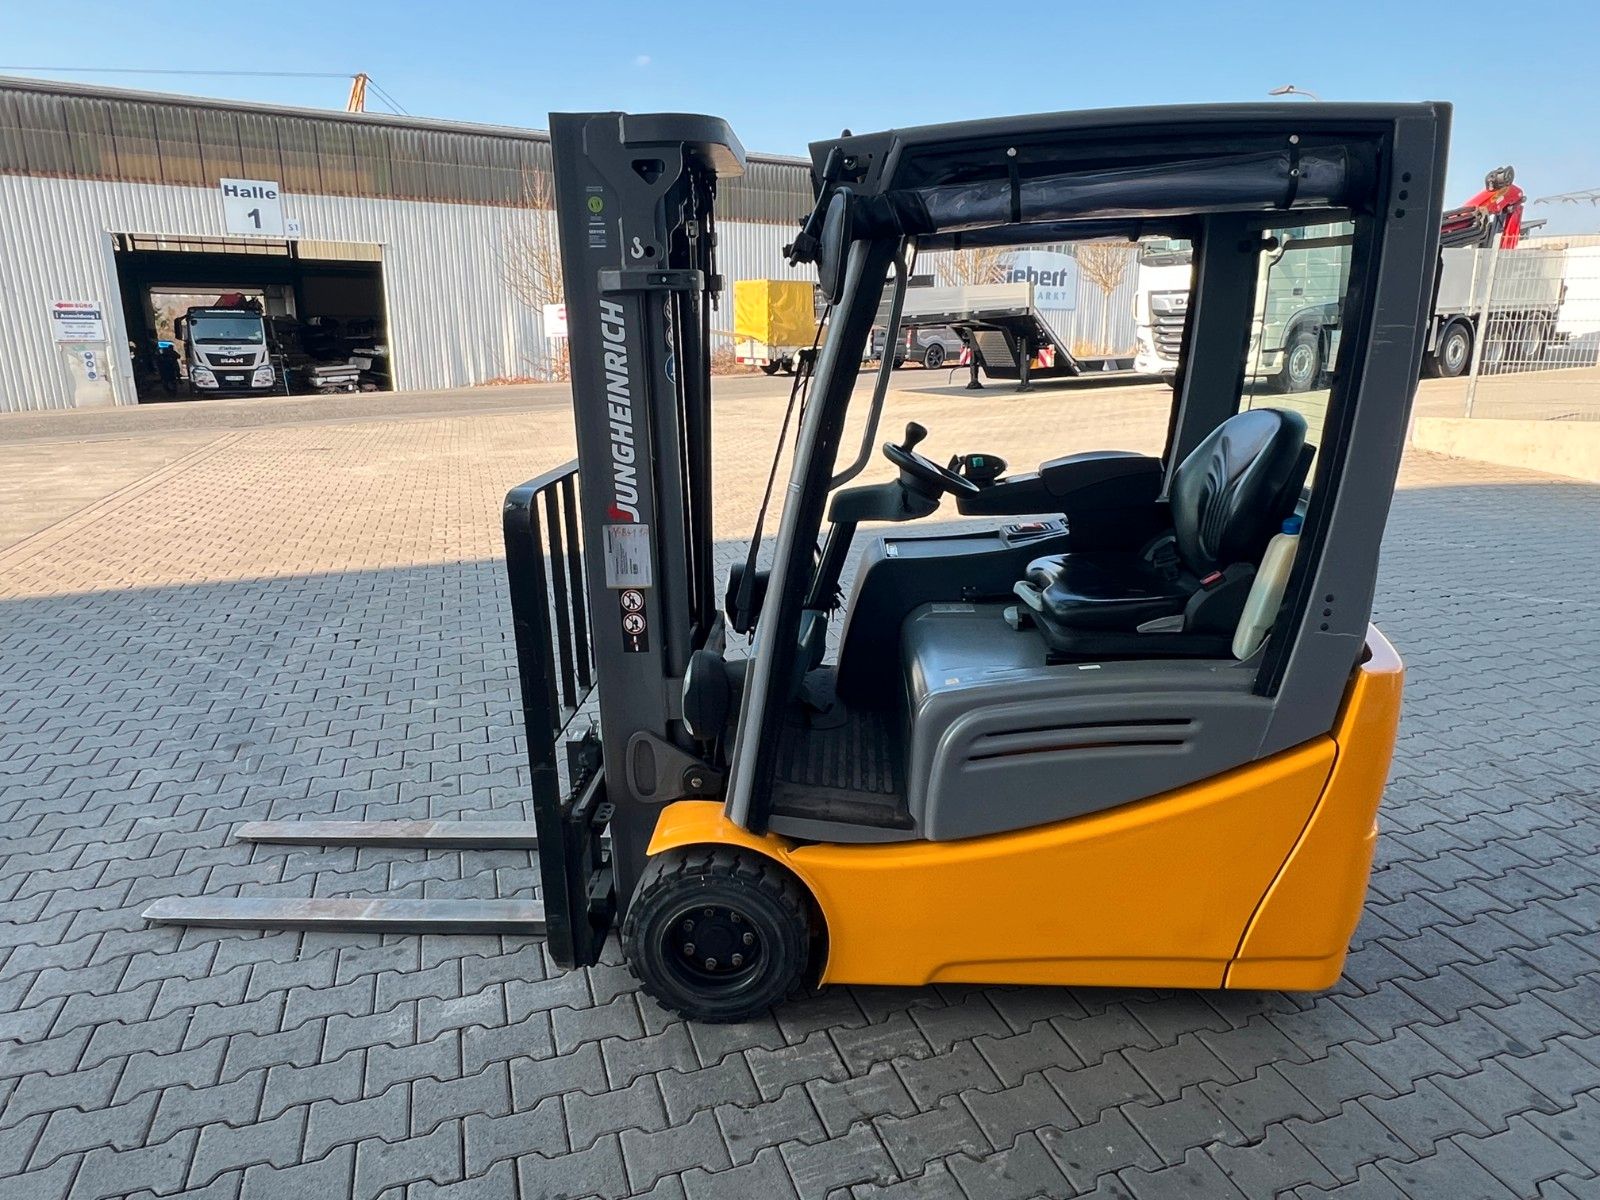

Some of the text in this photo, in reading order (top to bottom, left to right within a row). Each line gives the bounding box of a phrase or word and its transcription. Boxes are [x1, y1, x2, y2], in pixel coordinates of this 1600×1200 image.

[223, 184, 277, 200] Halle
[247, 208, 262, 229] 1
[1036, 291, 1067, 300] ARKT
[599, 300, 641, 524] JUNGHEINRICH
